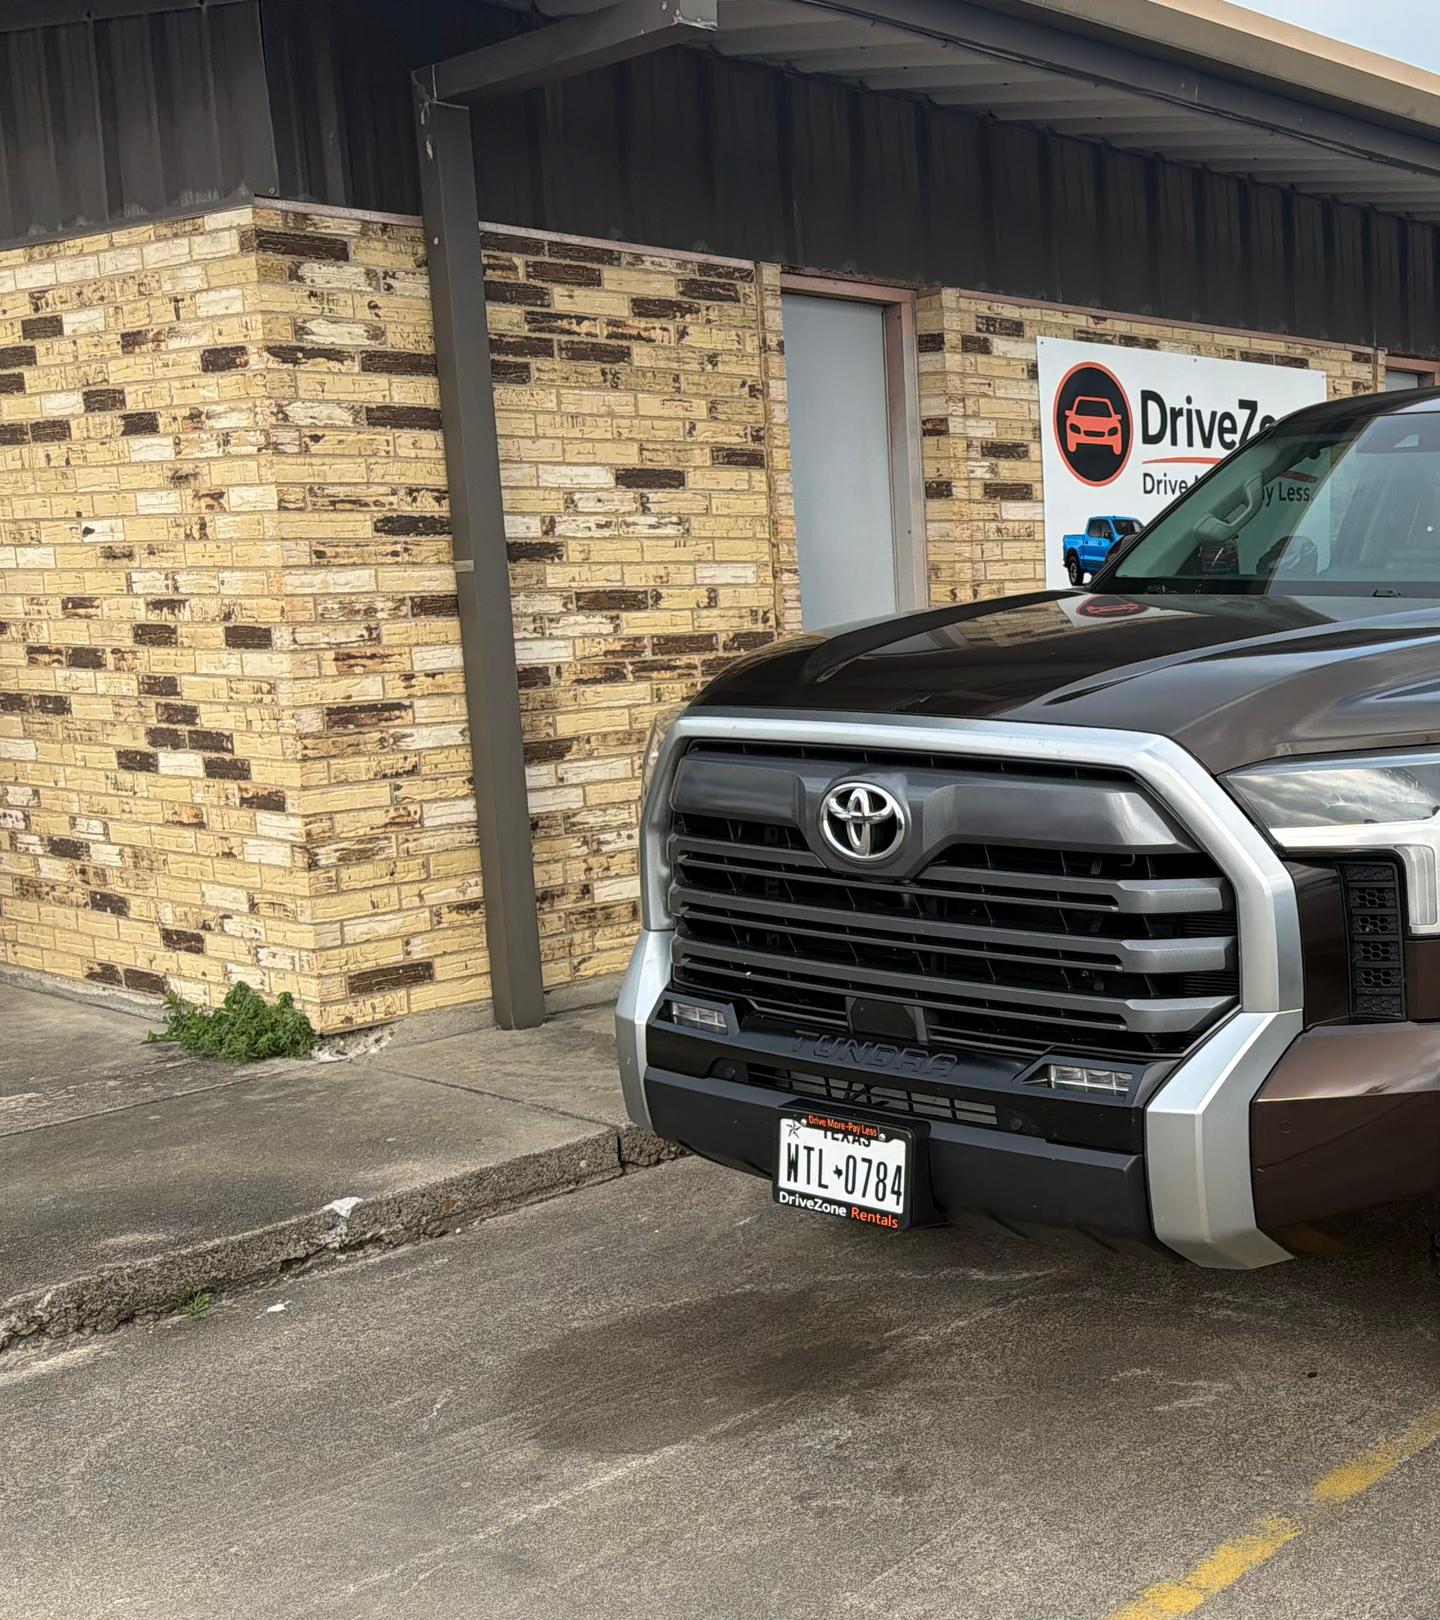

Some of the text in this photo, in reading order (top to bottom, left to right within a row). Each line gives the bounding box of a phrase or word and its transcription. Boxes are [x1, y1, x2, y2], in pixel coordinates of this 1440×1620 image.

[1143, 472, 1189, 495] Drive
[794, 1029, 958, 1077] TUNDRA
[807, 1114, 827, 1127] Drive
[861, 1124, 878, 1137] Less
[779, 1190, 899, 1229] DriveZone Rentals
